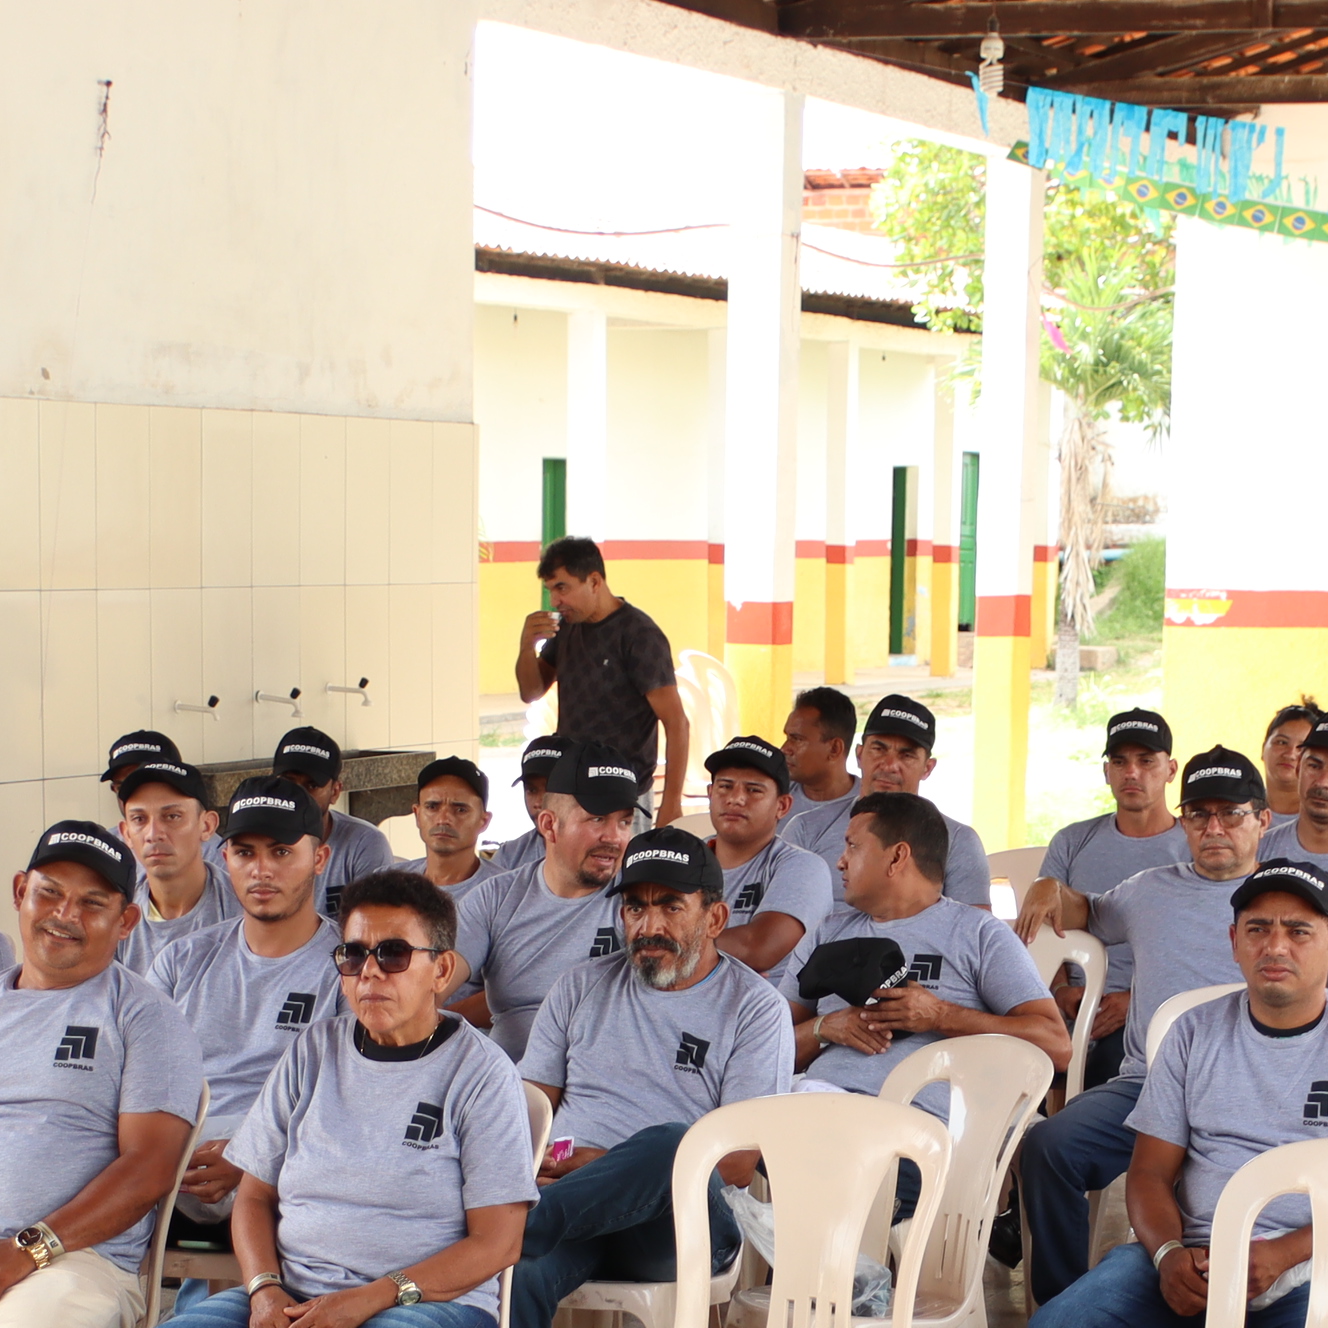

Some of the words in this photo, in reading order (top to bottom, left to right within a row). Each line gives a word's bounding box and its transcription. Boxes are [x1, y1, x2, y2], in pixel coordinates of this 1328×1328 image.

[1116, 721, 1159, 732] COOPBRAS
[118, 743, 162, 751] COOPBRAS
[290, 744, 330, 759] COOPBRAS
[528, 749, 562, 759] COOPBRA
[1195, 767, 1242, 778] COOPBRAS
[240, 797, 296, 809] COOPBRAS
[61, 832, 122, 861] COOPBRAS
[633, 850, 690, 863] COOPBRAS
[1264, 866, 1325, 889] COOPBRAS
[879, 963, 908, 989] OPBRA
[53, 1062, 94, 1072] COOPBRAS
